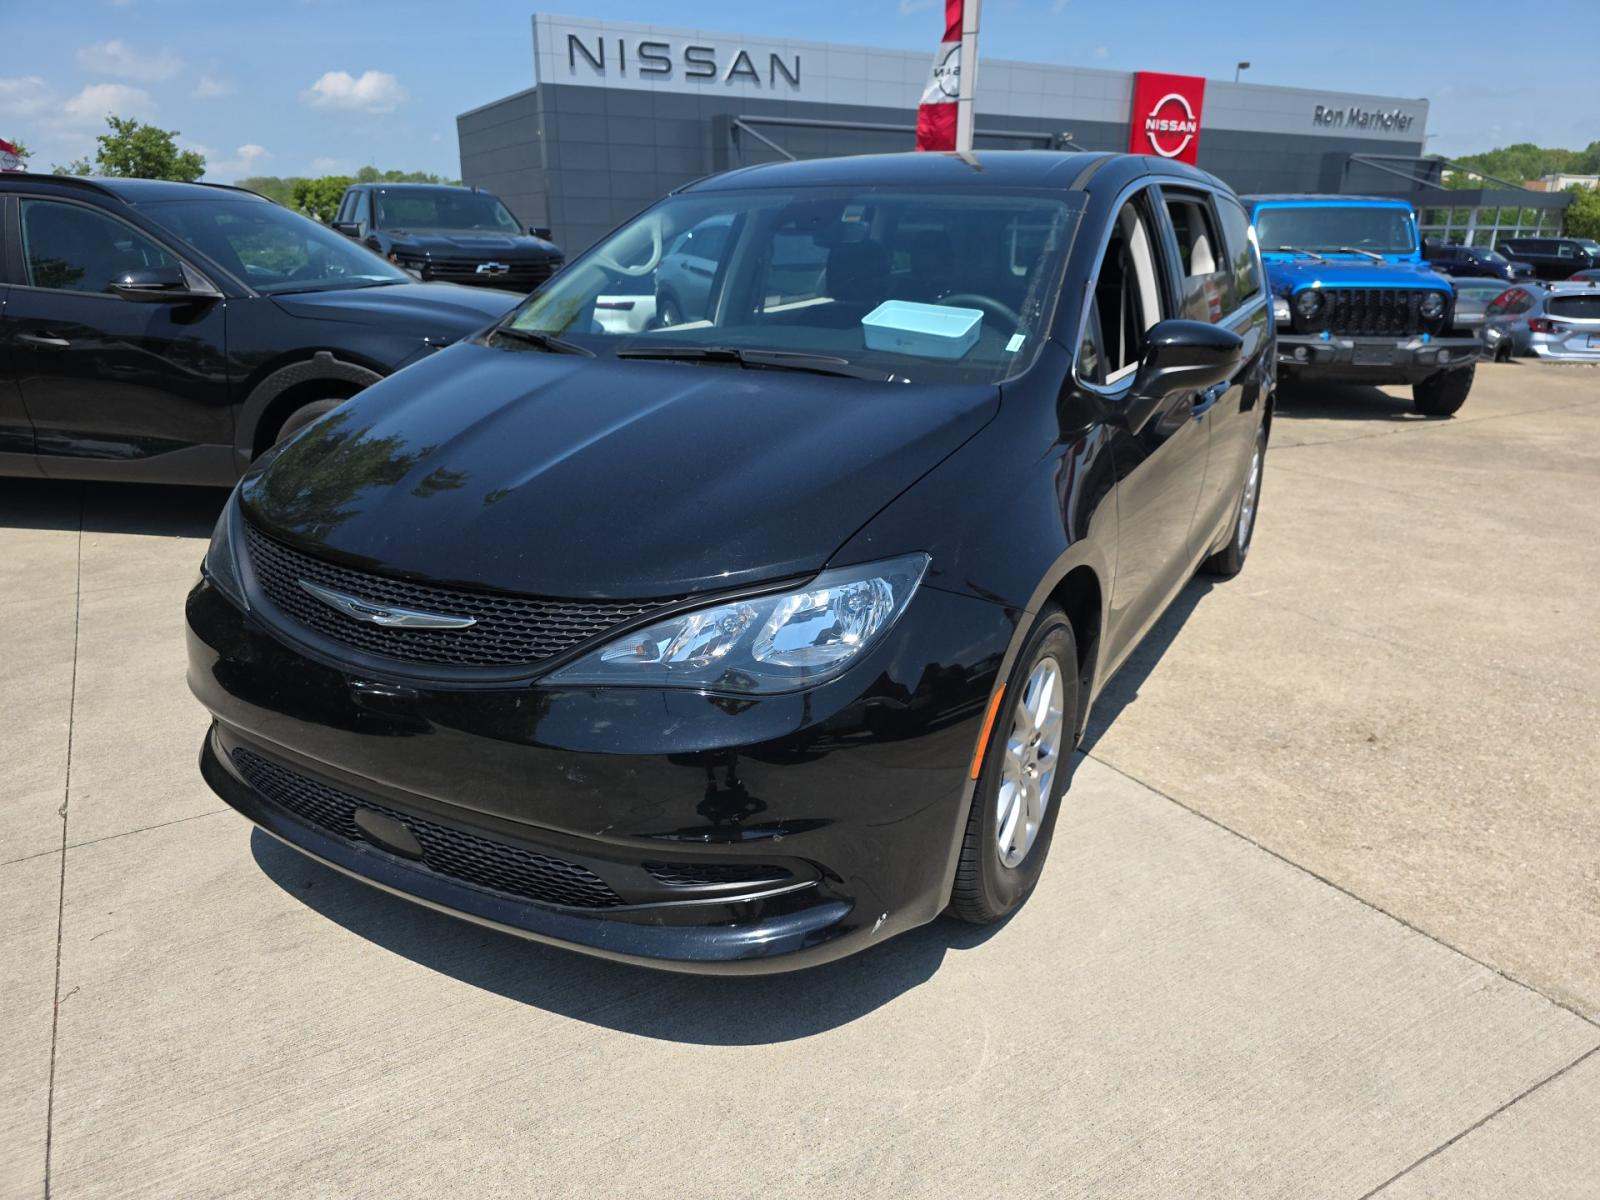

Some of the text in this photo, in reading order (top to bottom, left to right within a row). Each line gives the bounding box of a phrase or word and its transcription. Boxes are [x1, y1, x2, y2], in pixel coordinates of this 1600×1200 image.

[567, 34, 800, 86] NISSAN
[1145, 118, 1197, 133] NISSAN
[1313, 105, 1414, 130] Ron Marhofer
